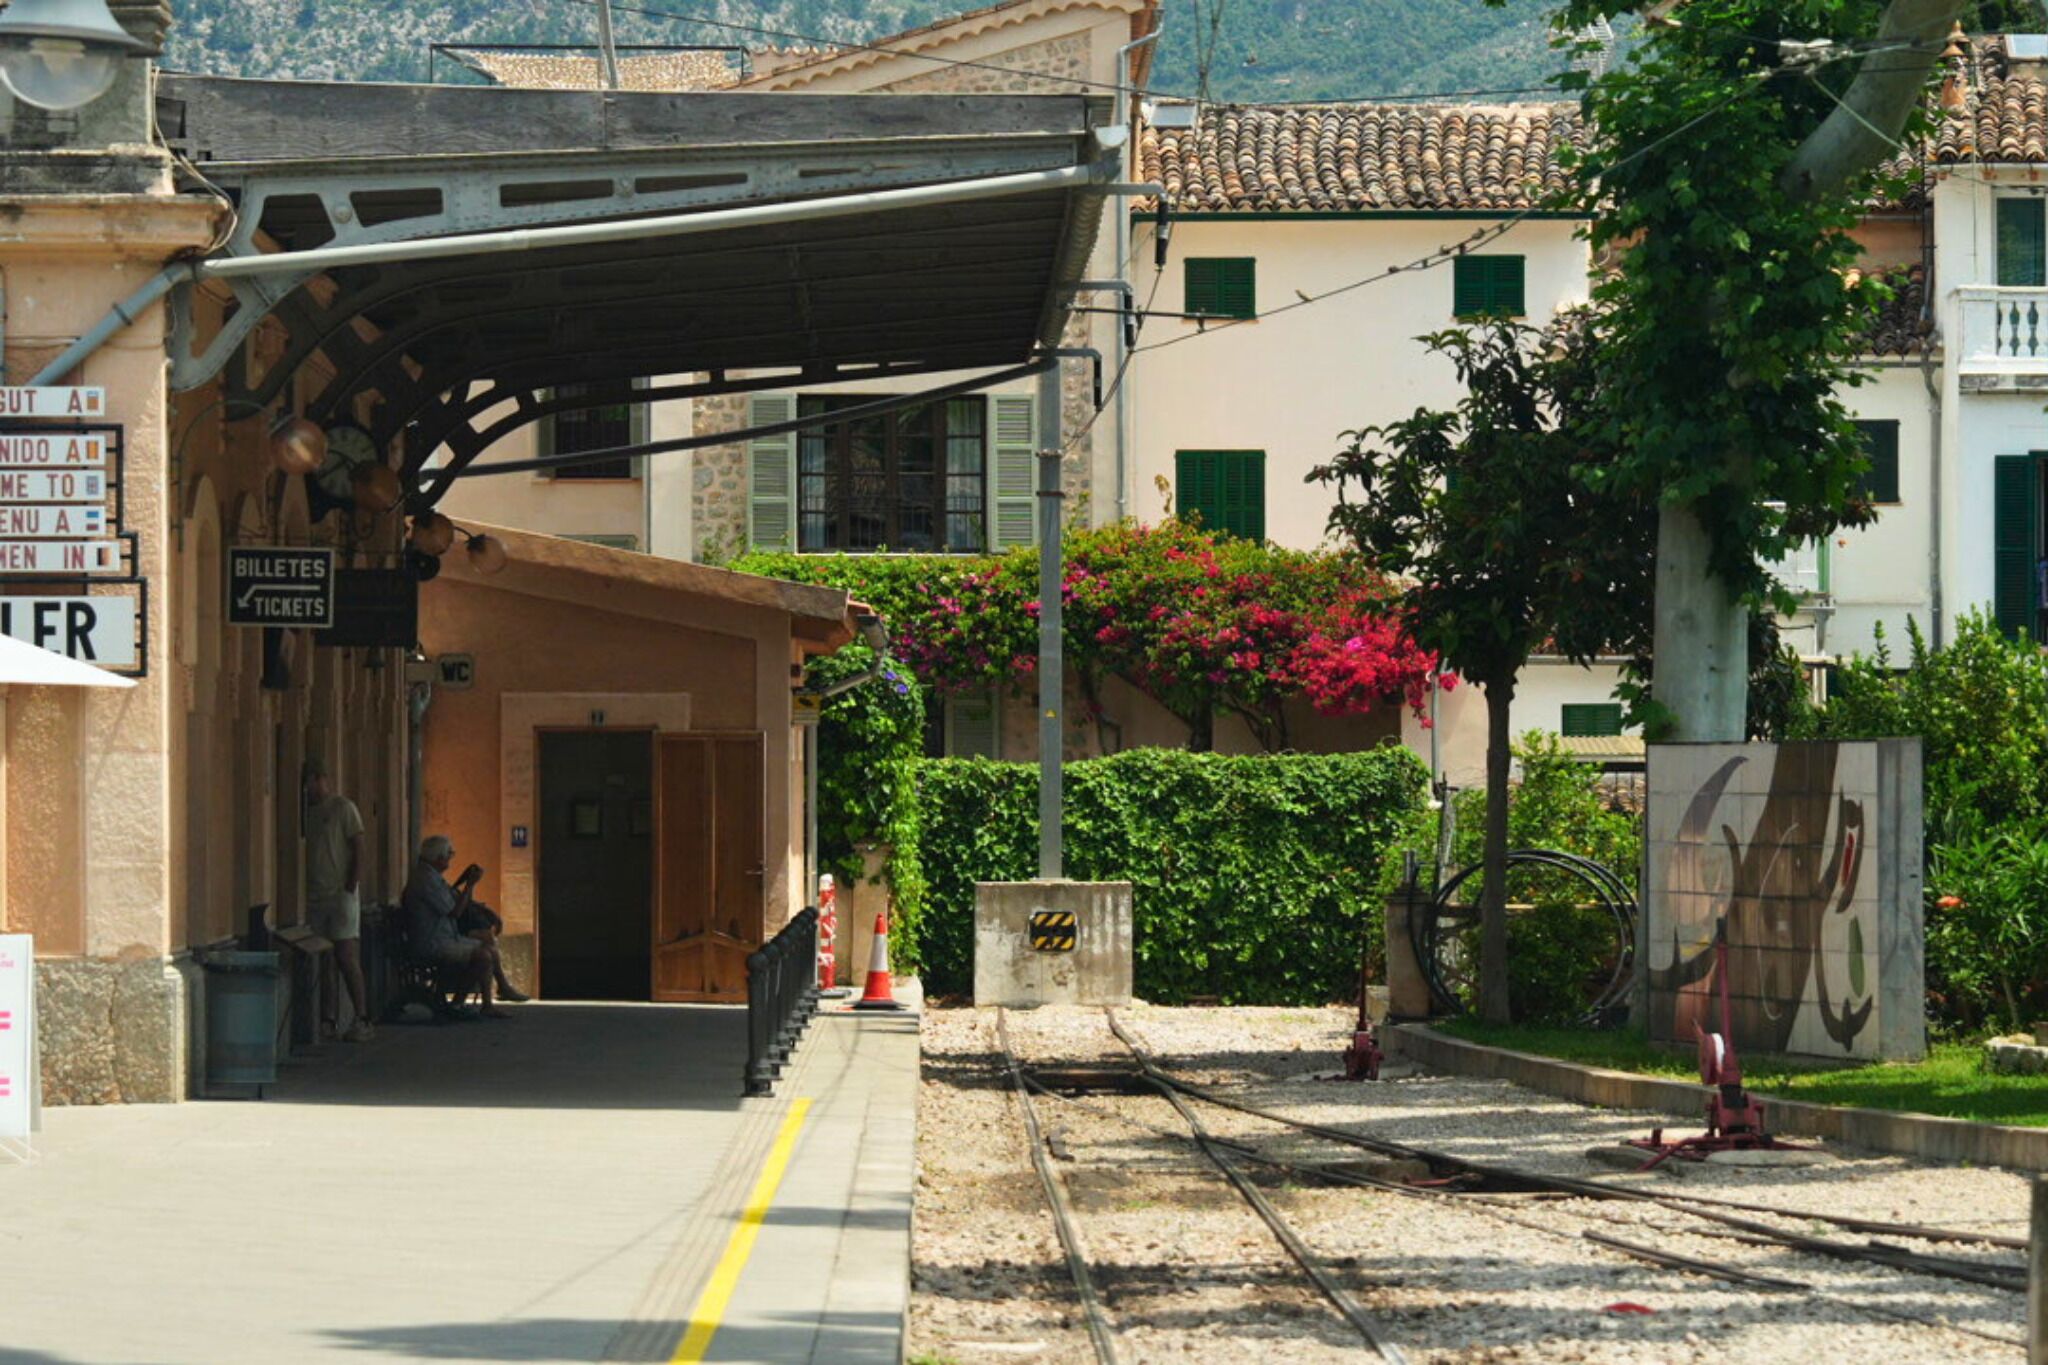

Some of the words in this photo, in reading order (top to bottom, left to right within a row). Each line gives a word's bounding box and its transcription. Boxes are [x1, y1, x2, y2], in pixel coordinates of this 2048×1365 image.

[68, 389, 82, 413] A
[0, 438, 49, 463] NIDO
[66, 438, 81, 462] A
[1, 474, 29, 498] ME
[46, 474, 75, 498] TO
[0, 509, 39, 533] ENU
[55, 509, 71, 533] A
[64, 544, 85, 569] IN
[235, 558, 326, 578] BILLETES
[255, 597, 325, 617] TICKETS
[441, 662, 469, 682] WC
